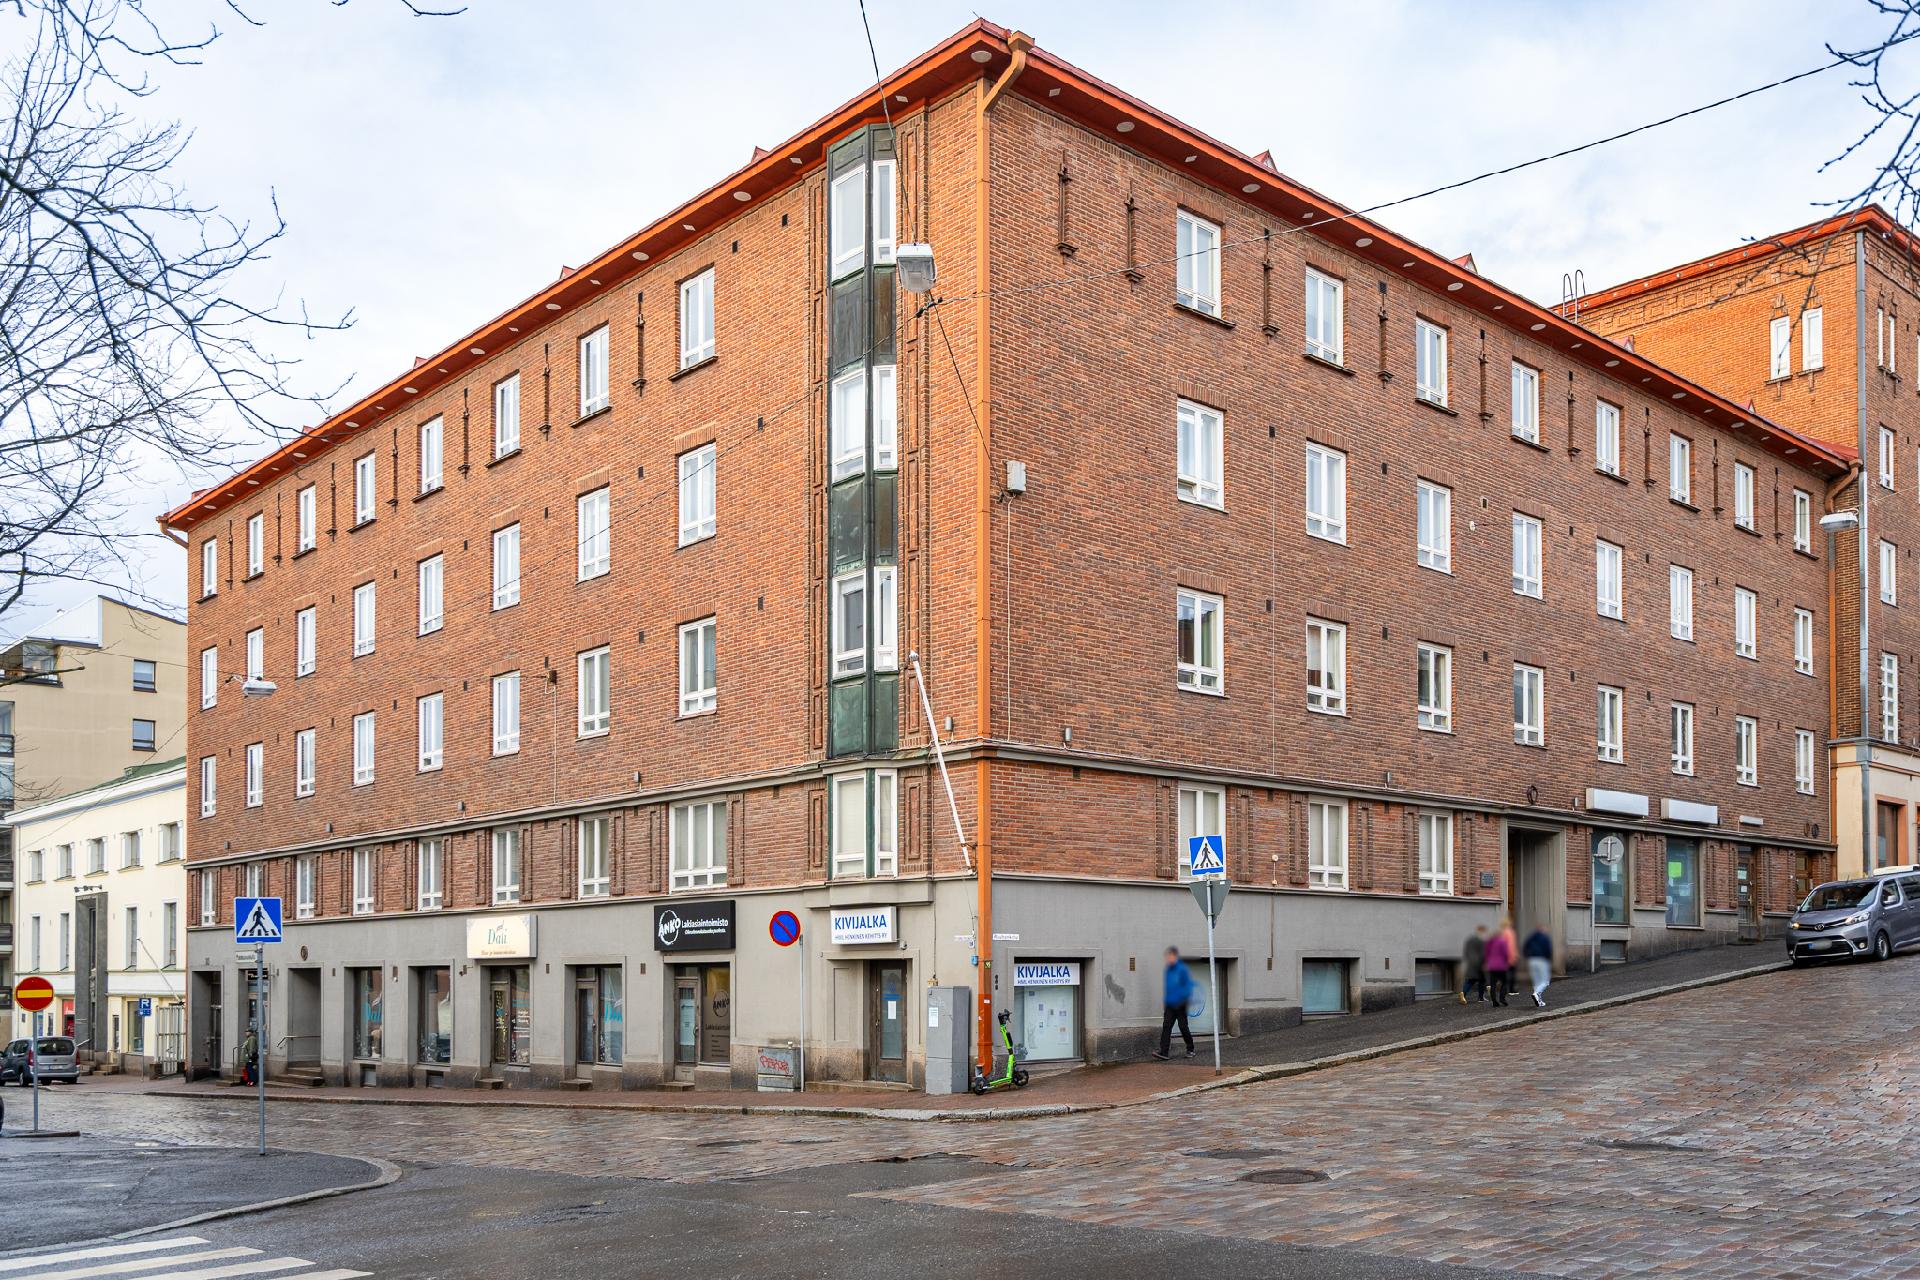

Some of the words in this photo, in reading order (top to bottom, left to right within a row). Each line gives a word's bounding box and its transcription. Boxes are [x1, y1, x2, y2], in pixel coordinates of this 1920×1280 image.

[658, 918, 681, 937] ANKO
[834, 914, 888, 930] KIVIJALKA
[1017, 965, 1071, 978] KIVIJALKA
